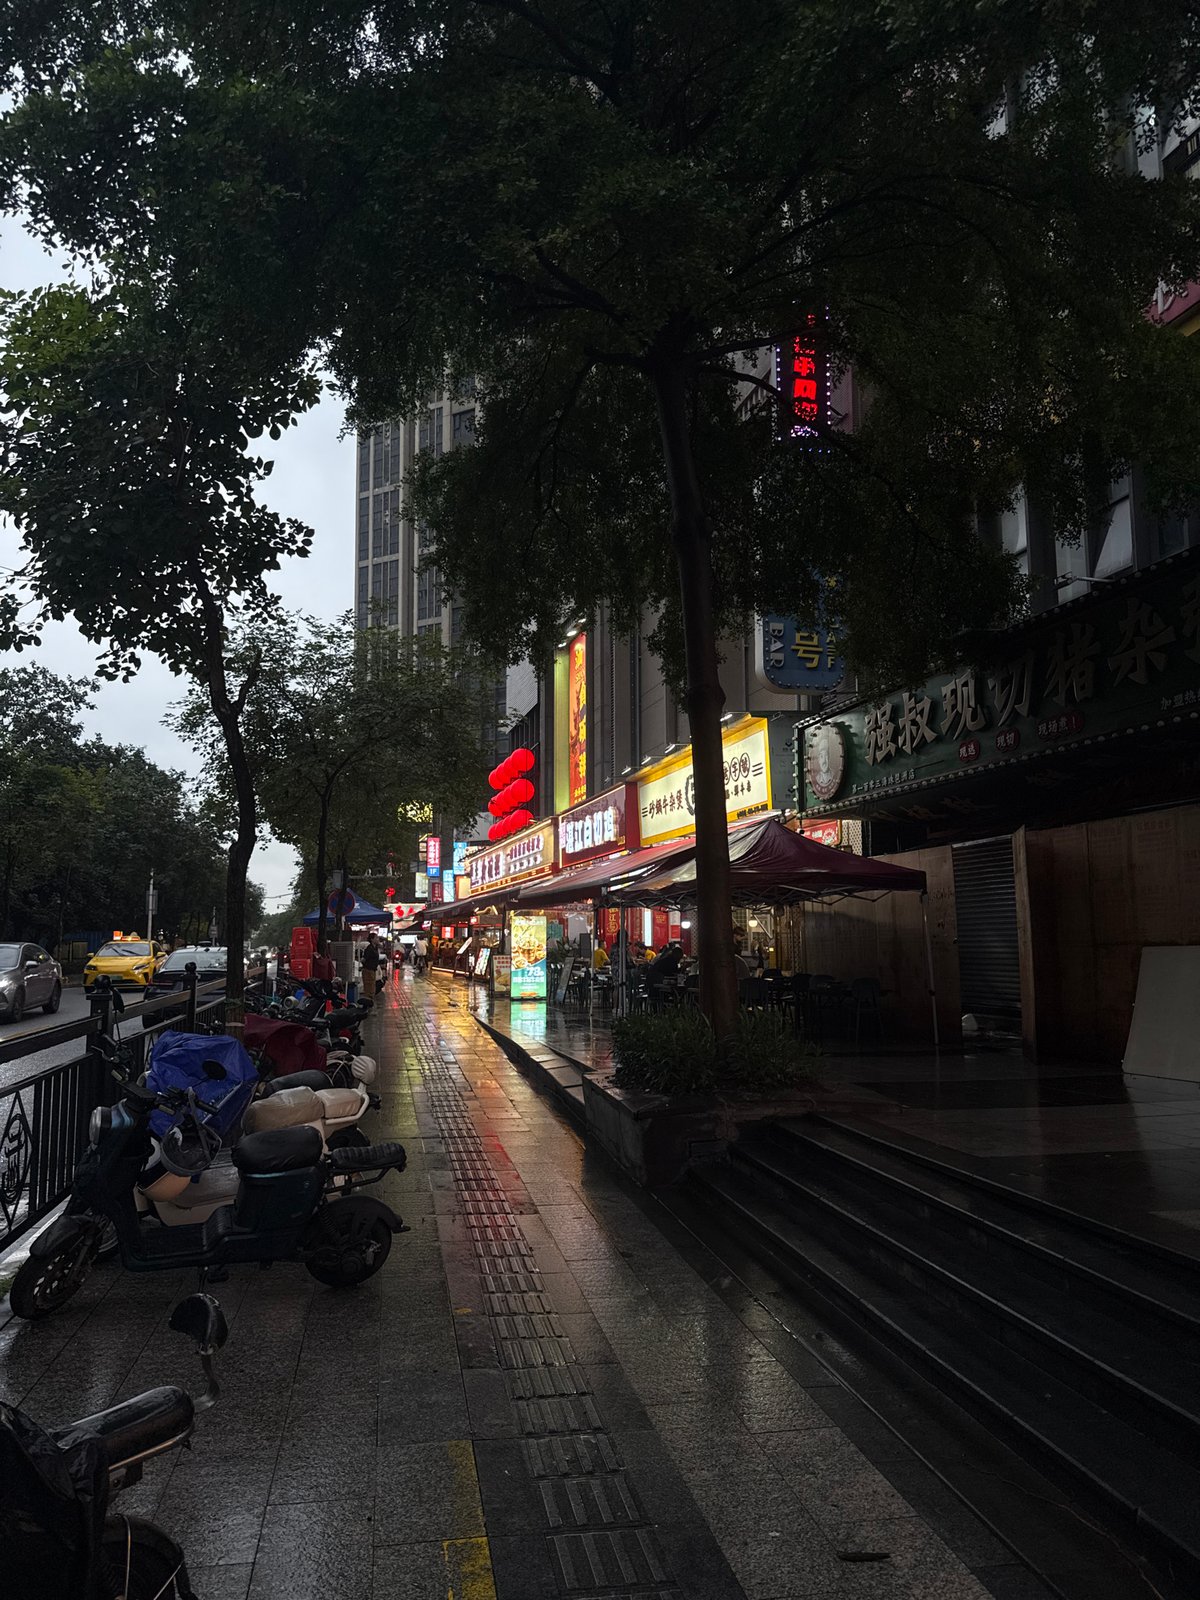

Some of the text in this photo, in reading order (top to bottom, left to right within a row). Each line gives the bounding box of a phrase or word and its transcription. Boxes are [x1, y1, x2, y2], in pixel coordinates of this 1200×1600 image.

[769, 622, 785, 668] BAR
[864, 577, 1200, 767] 强叔现切猪杂
